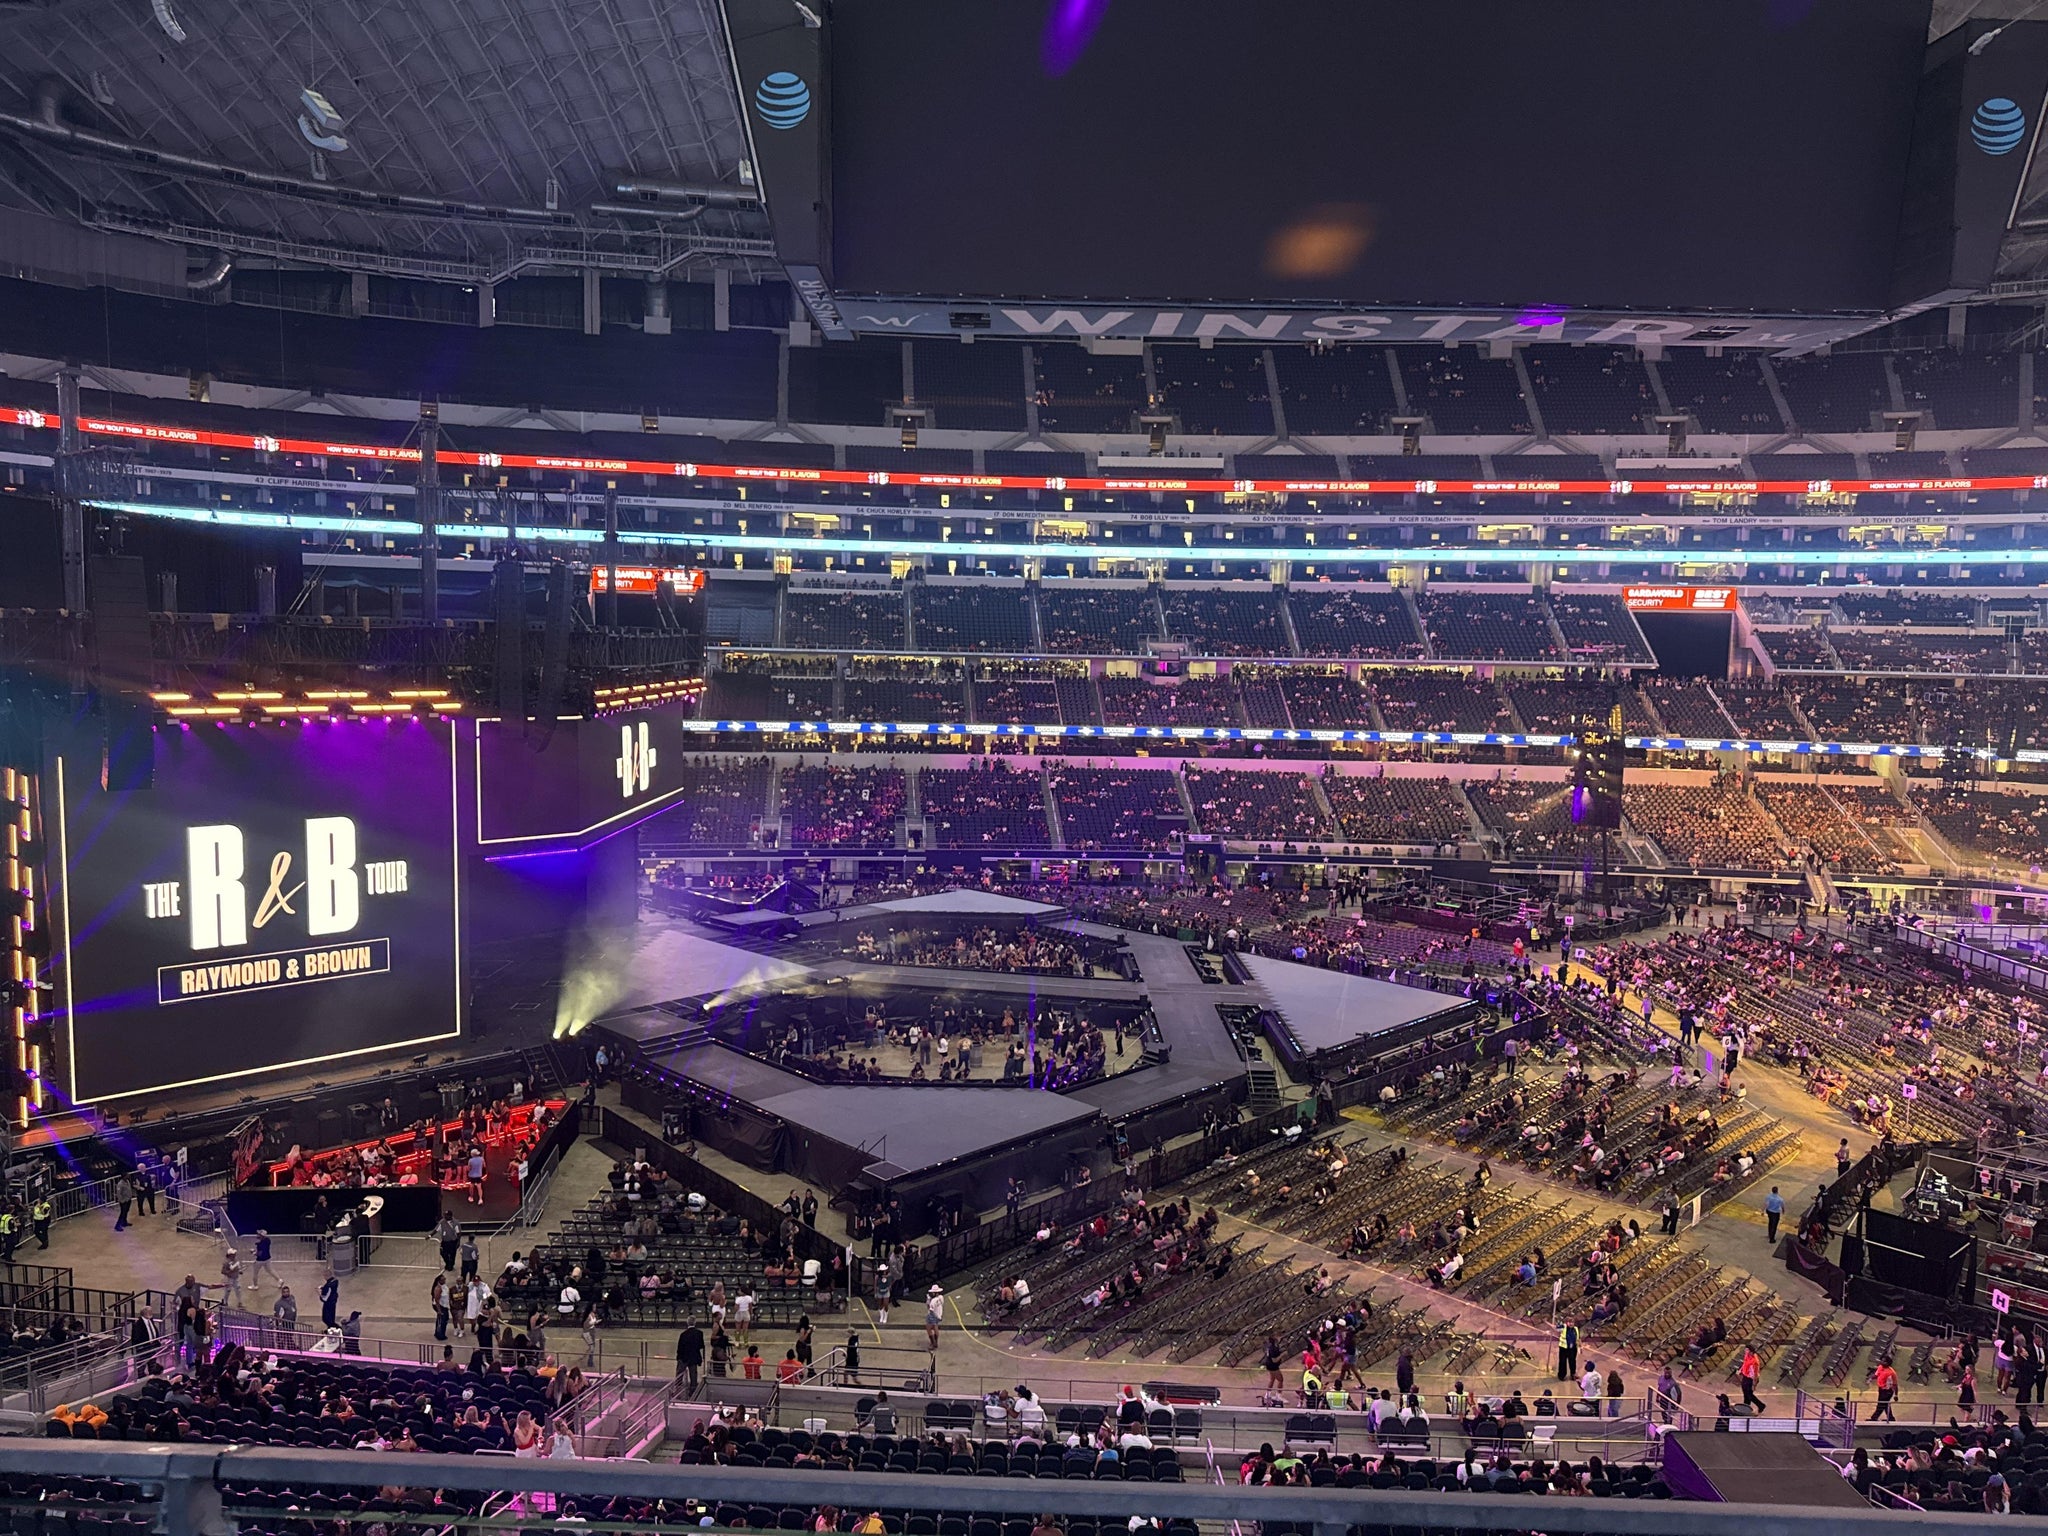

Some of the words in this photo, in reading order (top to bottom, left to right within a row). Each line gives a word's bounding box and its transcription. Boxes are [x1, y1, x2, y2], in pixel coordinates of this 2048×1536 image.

[798, 279, 845, 331] WINSTAR
[1000, 309, 1695, 343] WINSTAR
[146, 428, 157, 436] 23
[158, 430, 197, 440] FLAVORS
[595, 462, 627, 470] FLAVORS
[292, 479, 320, 487] HARRIS
[597, 569, 653, 580] GADAWORLD
[597, 579, 633, 587] SERITY
[1628, 589, 1684, 598] GARDAWORLD
[1695, 590, 1731, 599] BEST
[1627, 598, 1664, 606] SECURITY
[142, 881, 181, 918] THE
[187, 824, 248, 950] R
[252, 851, 306, 929] &
[305, 816, 359, 936] B
[364, 860, 408, 895] TOUR
[181, 958, 281, 994] RAYMOND
[285, 958, 300, 980] &
[305, 946, 371, 977] BROWN
